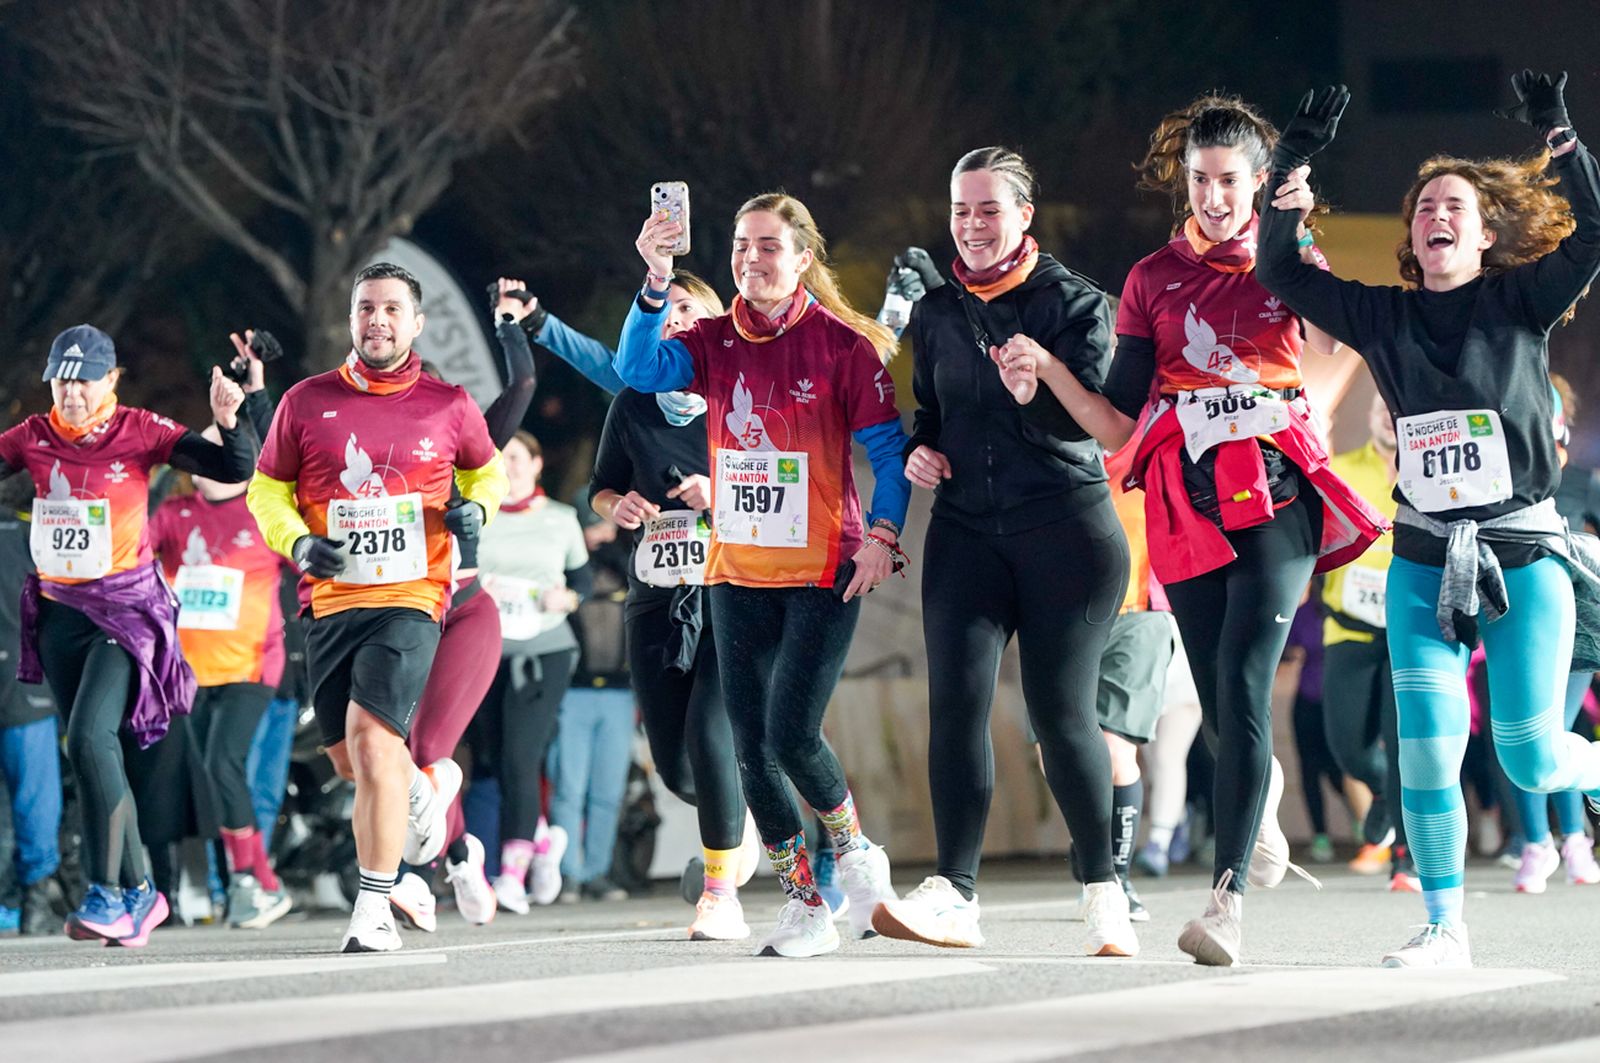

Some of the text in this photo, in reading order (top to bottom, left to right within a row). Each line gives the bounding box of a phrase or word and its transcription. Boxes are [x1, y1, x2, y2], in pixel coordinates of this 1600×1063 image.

[1206, 351, 1232, 372] 43
[1414, 419, 1458, 436] NOCHE DE
[1409, 438, 1426, 451] SAN
[731, 461, 768, 471] NOCHE DE
[1422, 441, 1482, 478] 6178
[725, 473, 738, 482] SAN
[731, 485, 785, 513] 7597
[348, 508, 387, 519] NOCHE DE
[339, 520, 356, 529] SAN
[678, 519, 688, 528] DE
[52, 528, 90, 550] 923
[348, 527, 406, 555] 2378
[651, 540, 705, 569] 2379
